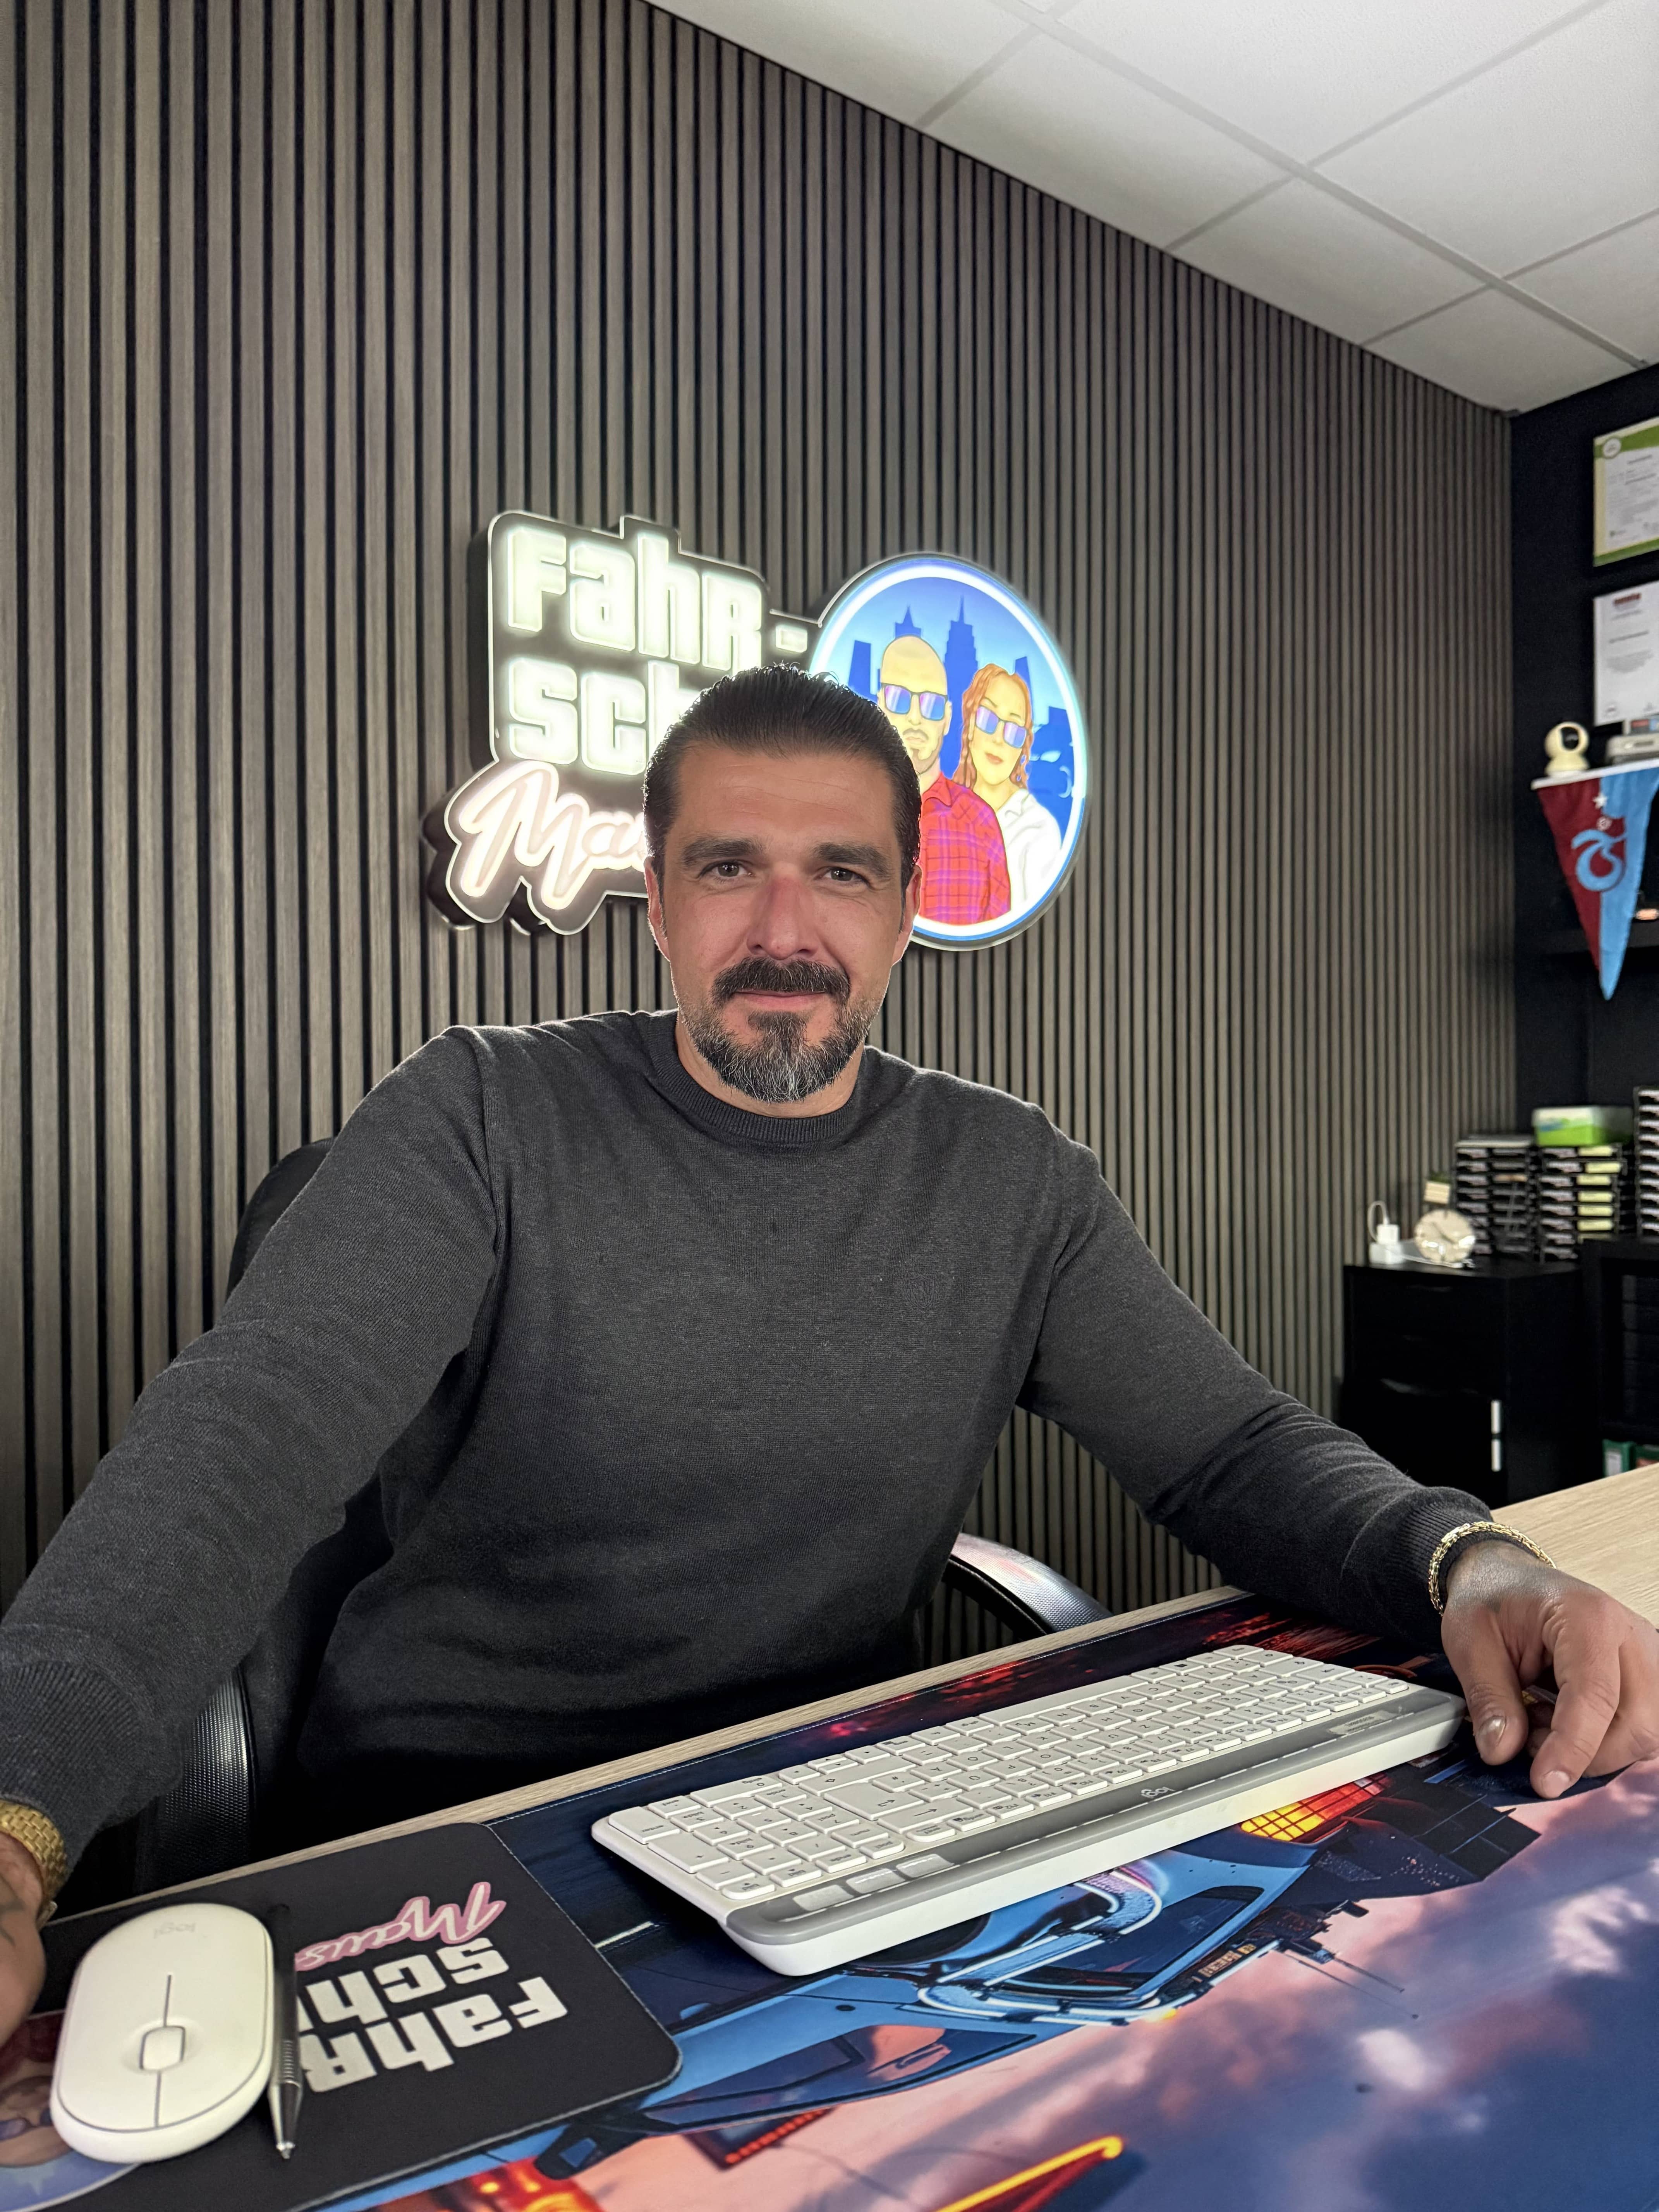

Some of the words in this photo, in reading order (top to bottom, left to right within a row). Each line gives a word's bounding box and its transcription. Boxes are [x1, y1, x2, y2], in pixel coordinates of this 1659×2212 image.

[461, 762, 644, 908] Ma
[1140, 1787, 1176, 1798] logi
[153, 1923, 196, 1939] logi
